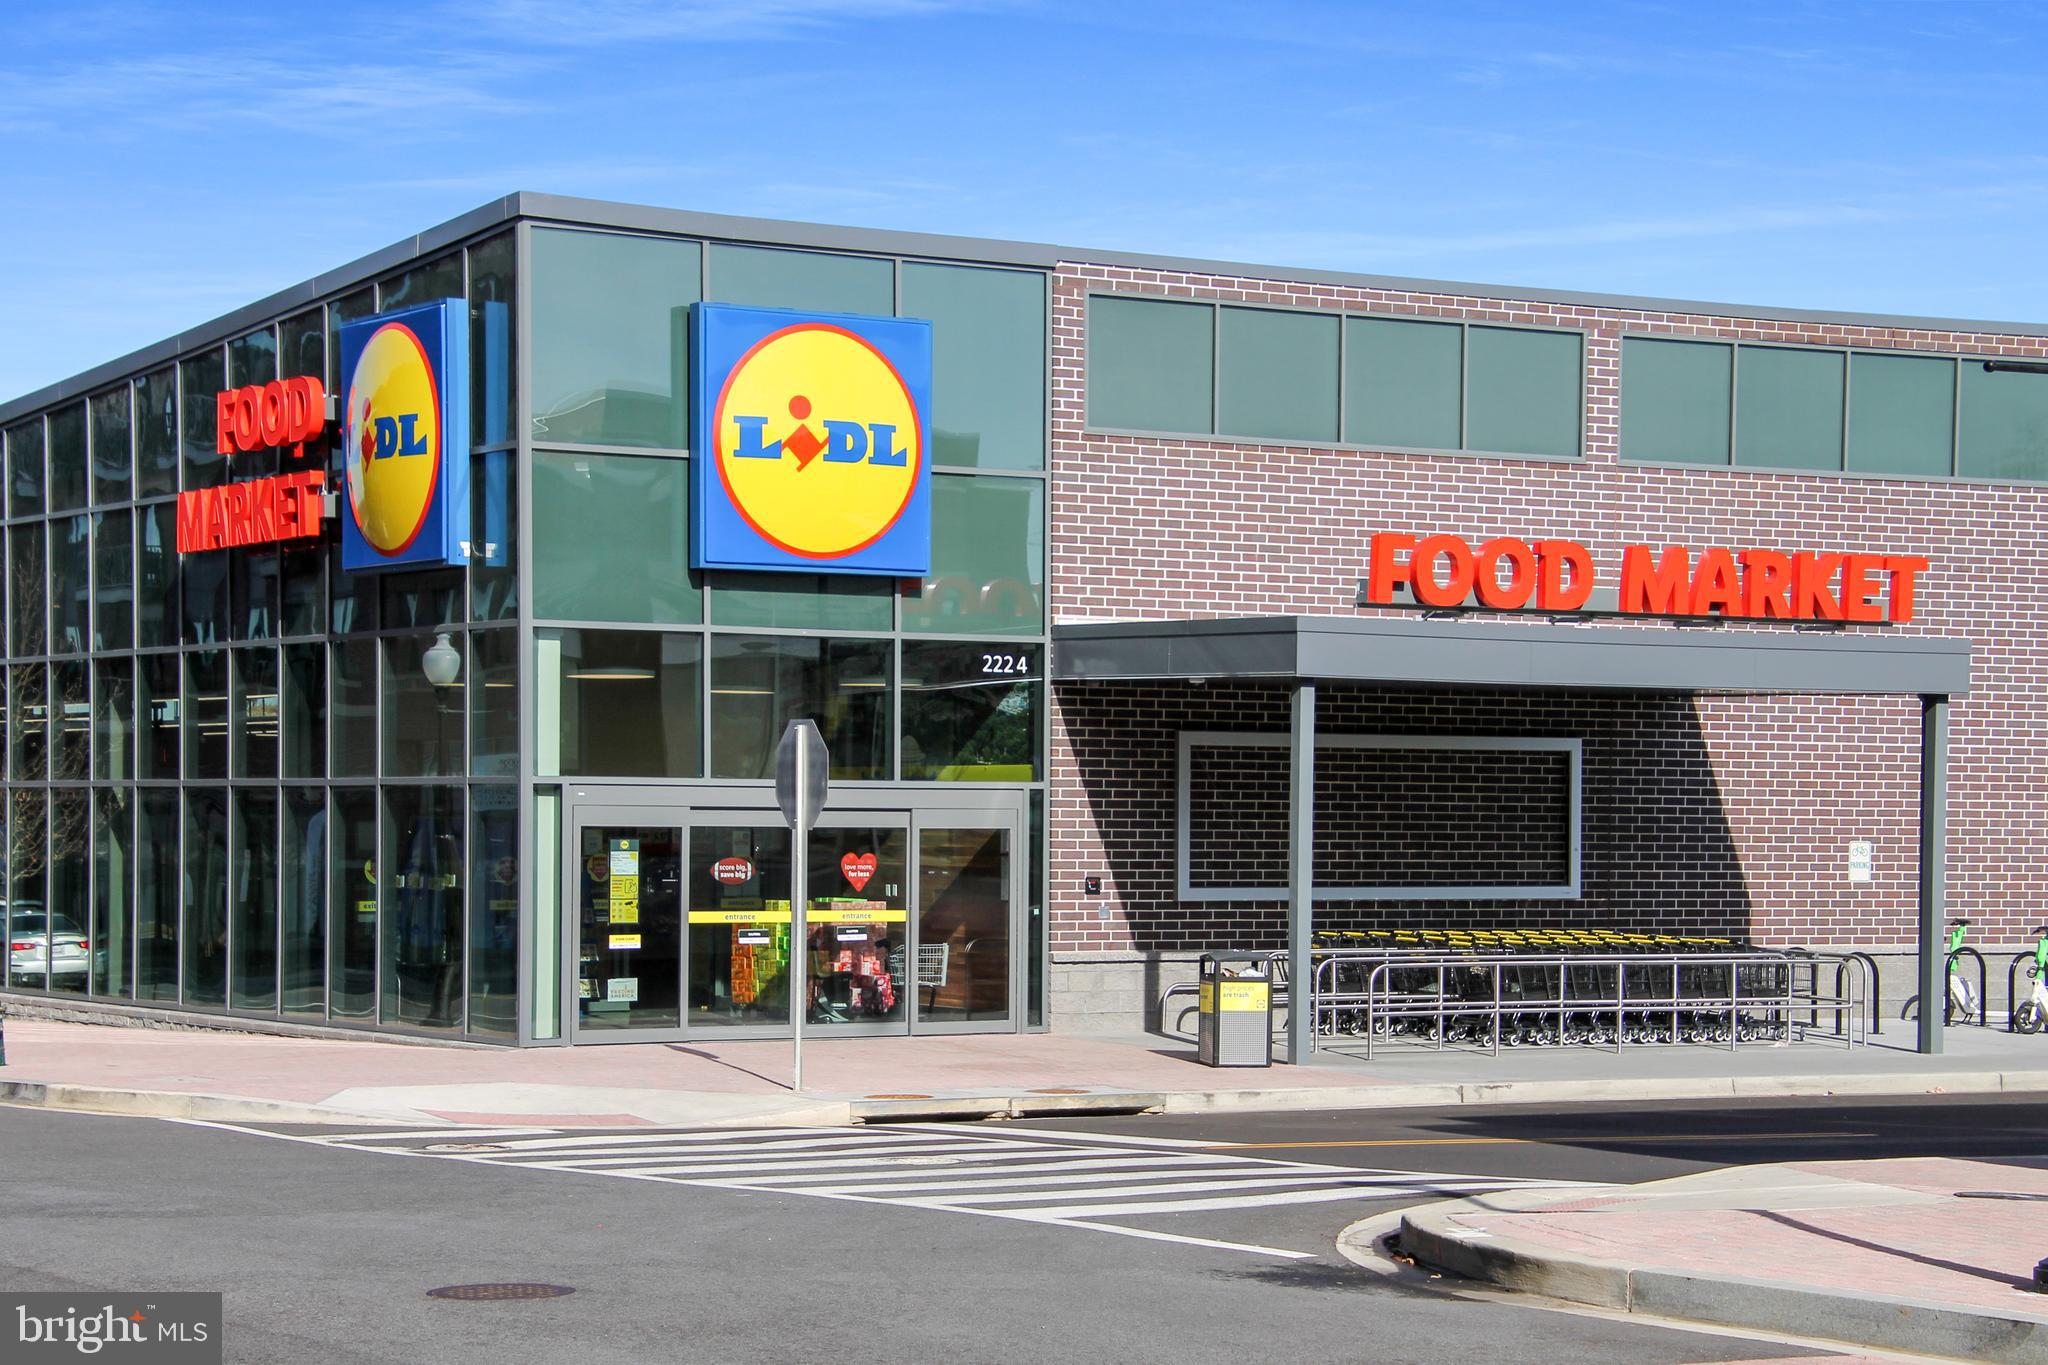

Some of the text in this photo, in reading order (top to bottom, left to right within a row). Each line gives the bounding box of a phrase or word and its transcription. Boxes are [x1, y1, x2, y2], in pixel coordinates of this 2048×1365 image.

[217, 376, 325, 454] FOOD
[177, 470, 325, 553] MARKET
[1367, 533, 1929, 622] FOOD MARKET
[982, 655, 1028, 674] 2224
[735, 864, 748, 872] big,
[735, 871, 746, 879] big
